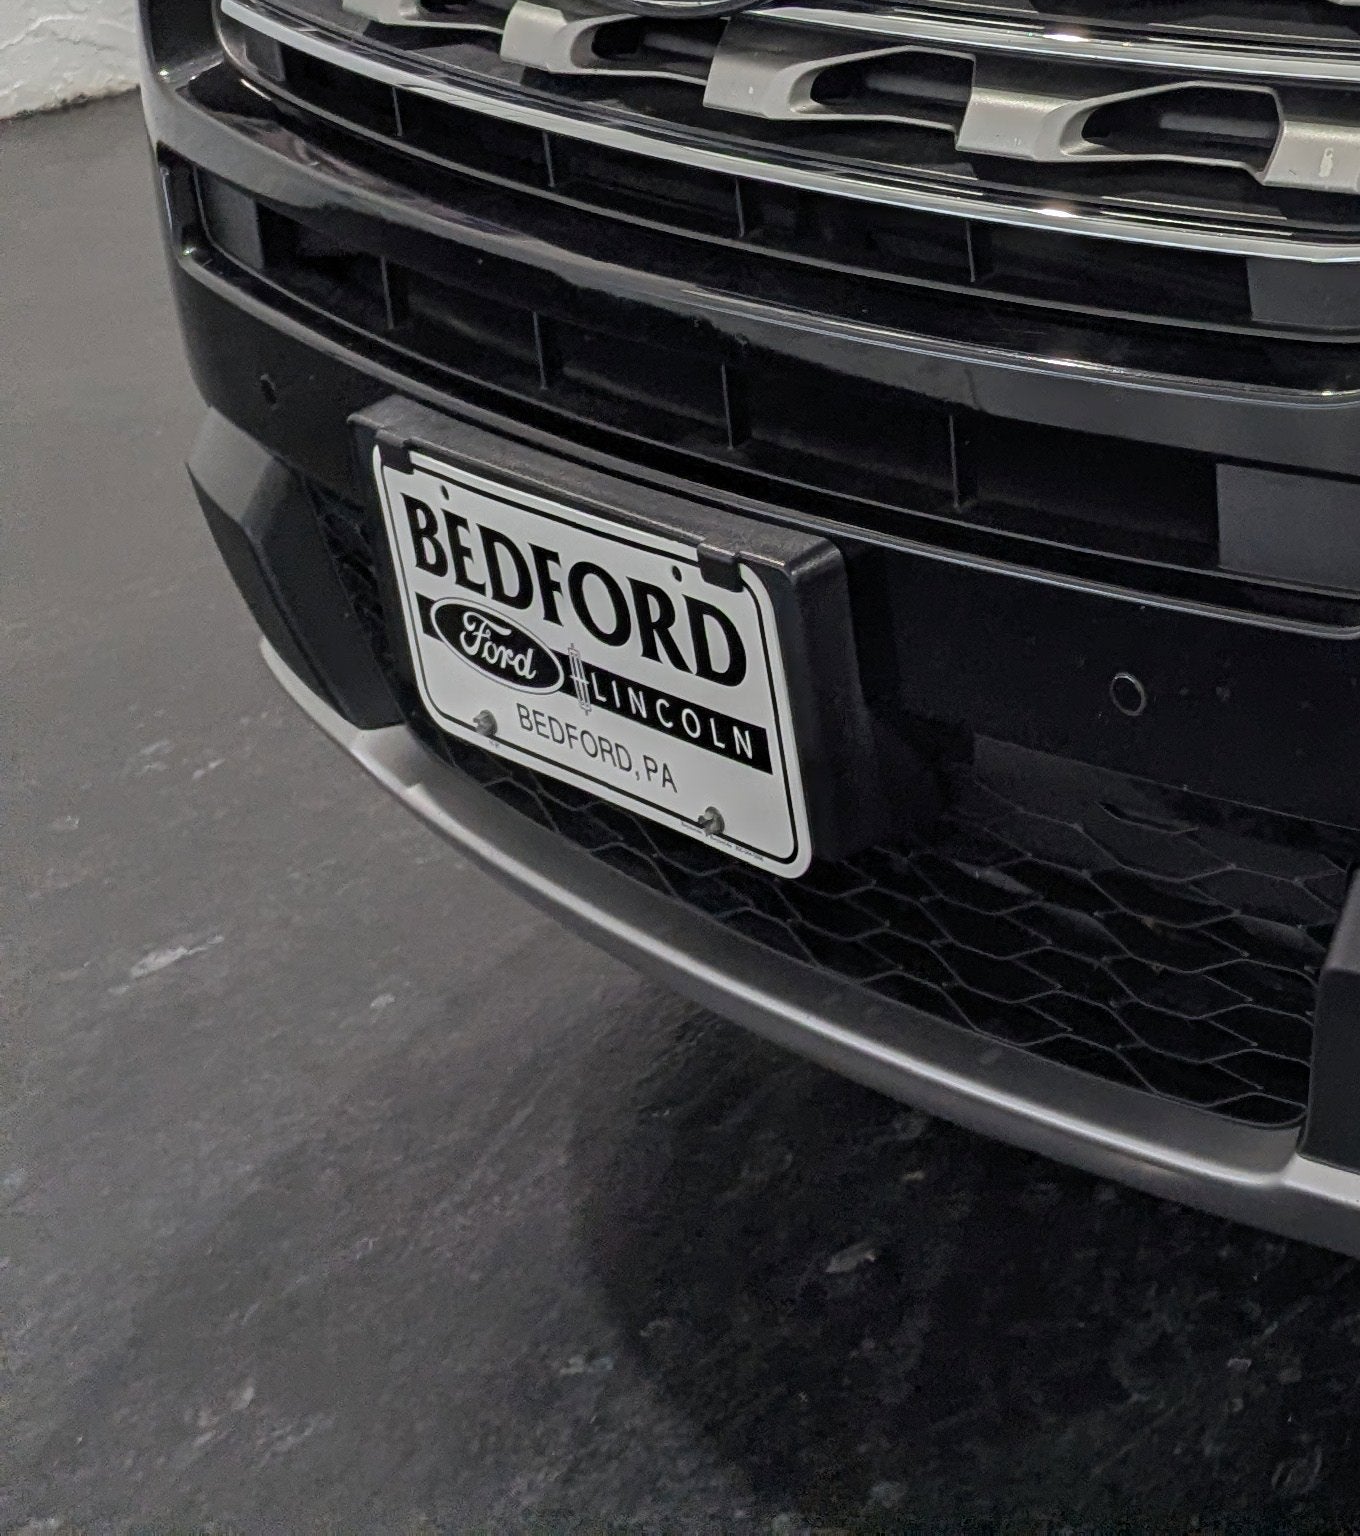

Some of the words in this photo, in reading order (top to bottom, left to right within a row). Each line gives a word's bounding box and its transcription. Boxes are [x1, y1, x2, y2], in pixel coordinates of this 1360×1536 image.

[400, 491, 748, 688] BEDFORD
[459, 608, 537, 681] Ford
[590, 680, 753, 761] LINCOLN
